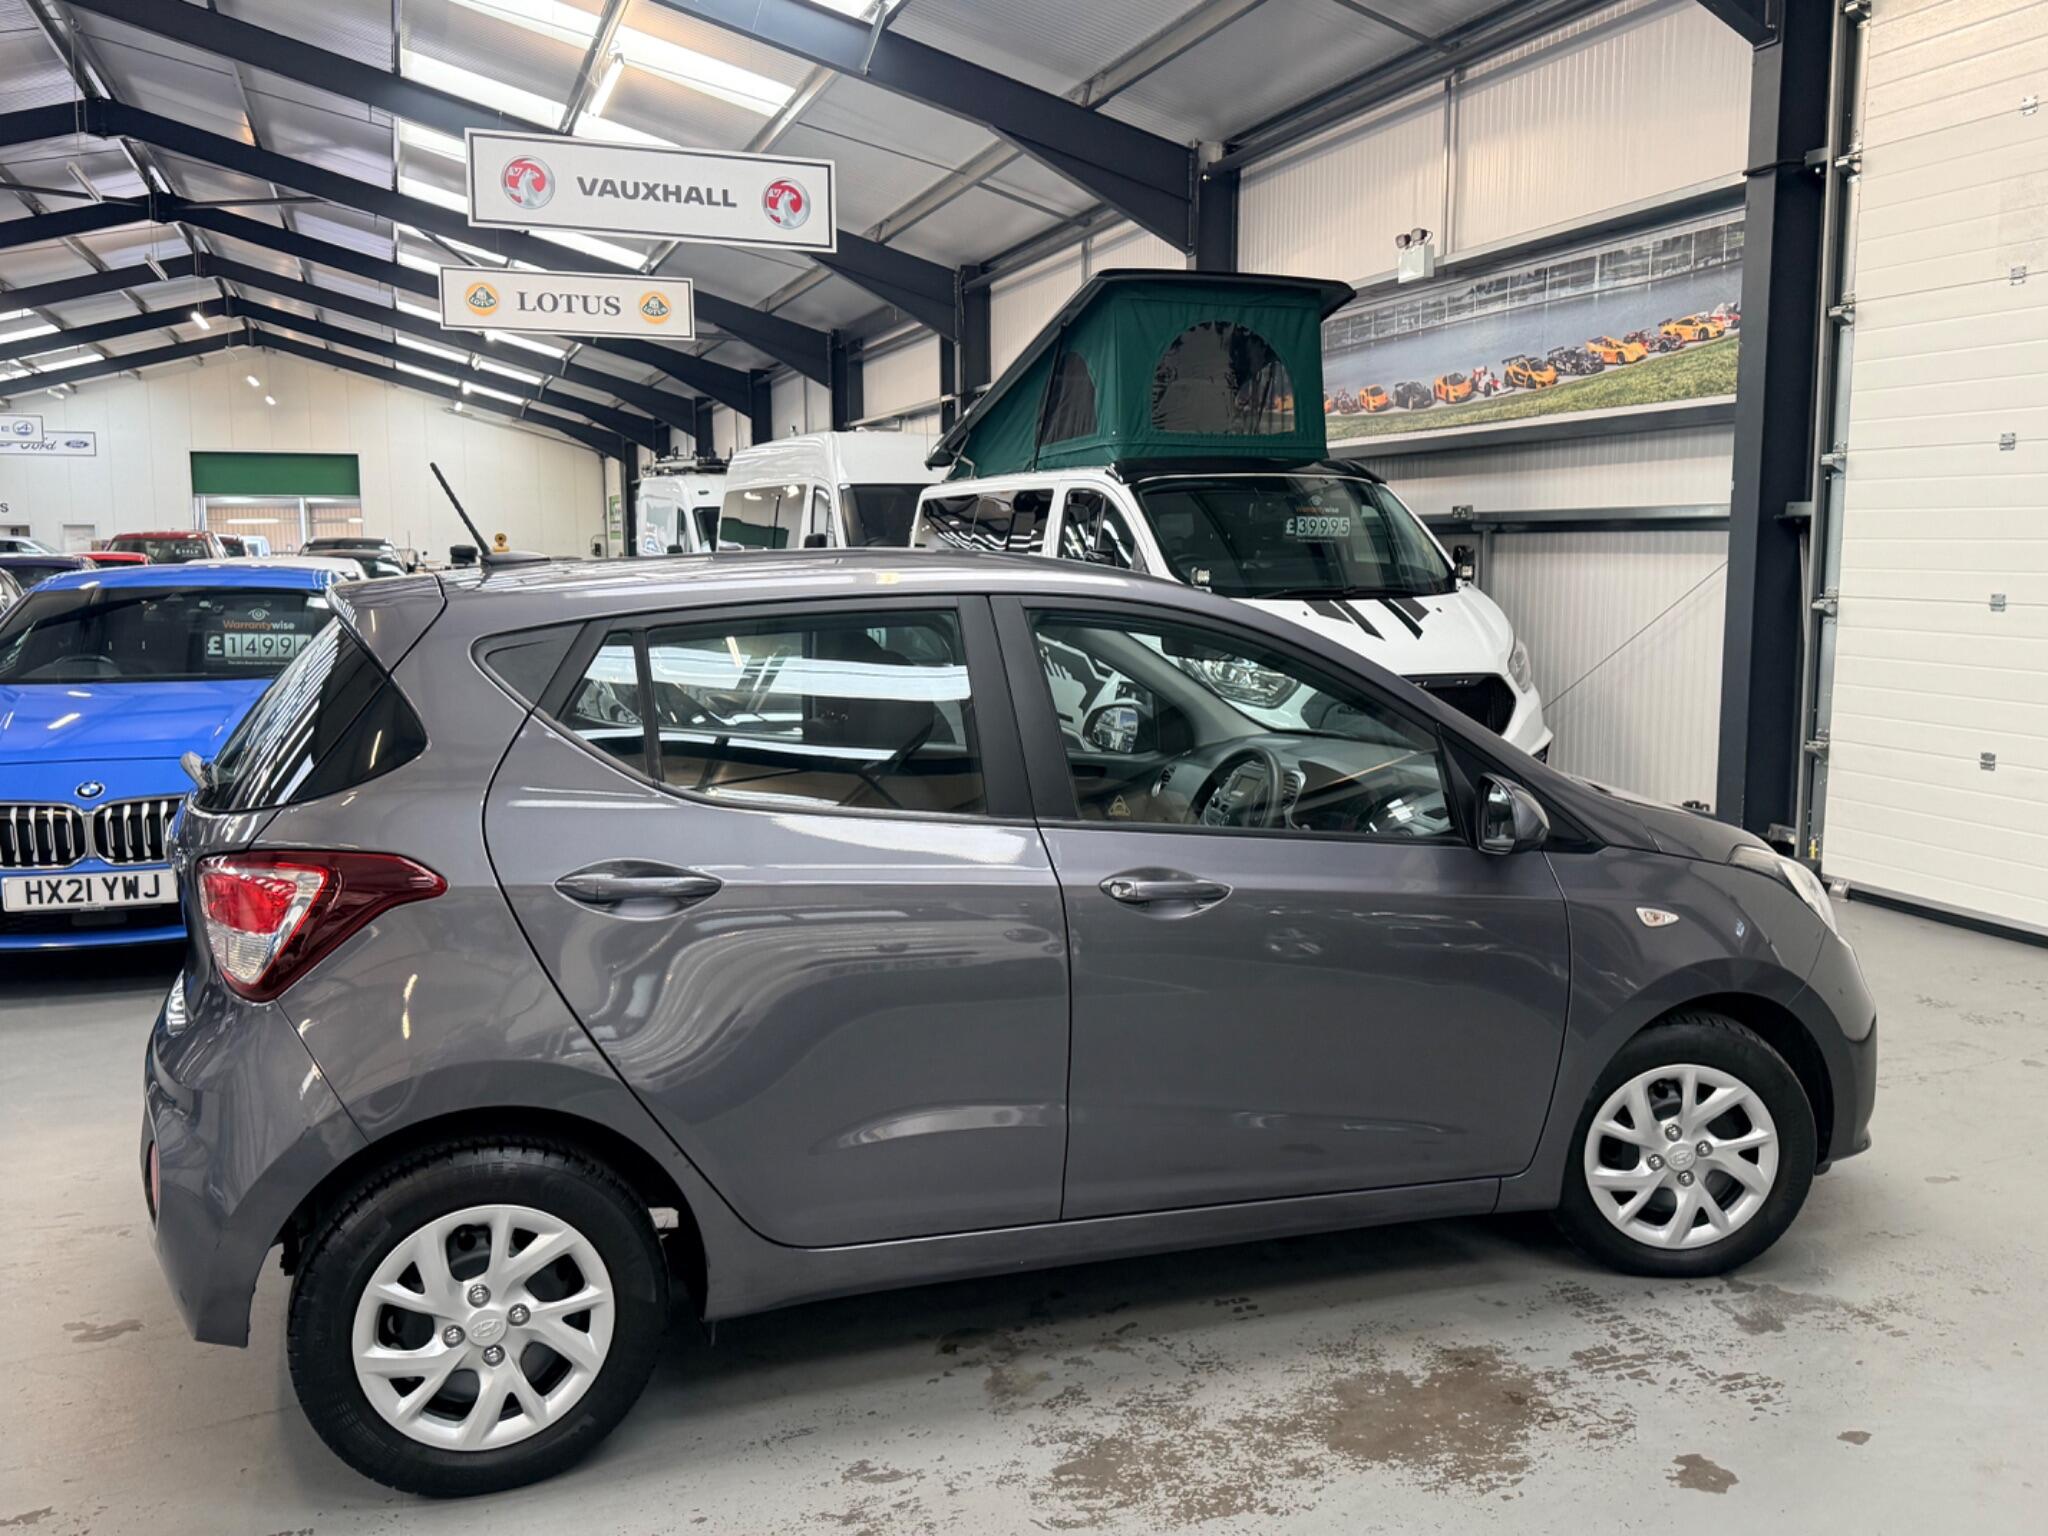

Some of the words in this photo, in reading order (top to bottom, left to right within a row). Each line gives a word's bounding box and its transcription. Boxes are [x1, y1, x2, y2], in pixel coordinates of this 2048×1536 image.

[576, 176, 738, 208] VAUXHALL
[516, 291, 622, 316] LOTUS
[1285, 517, 1349, 535] £39995
[223, 620, 295, 631] Warrantywise
[25, 878, 93, 905] HX21
[102, 874, 160, 901] YWJ
